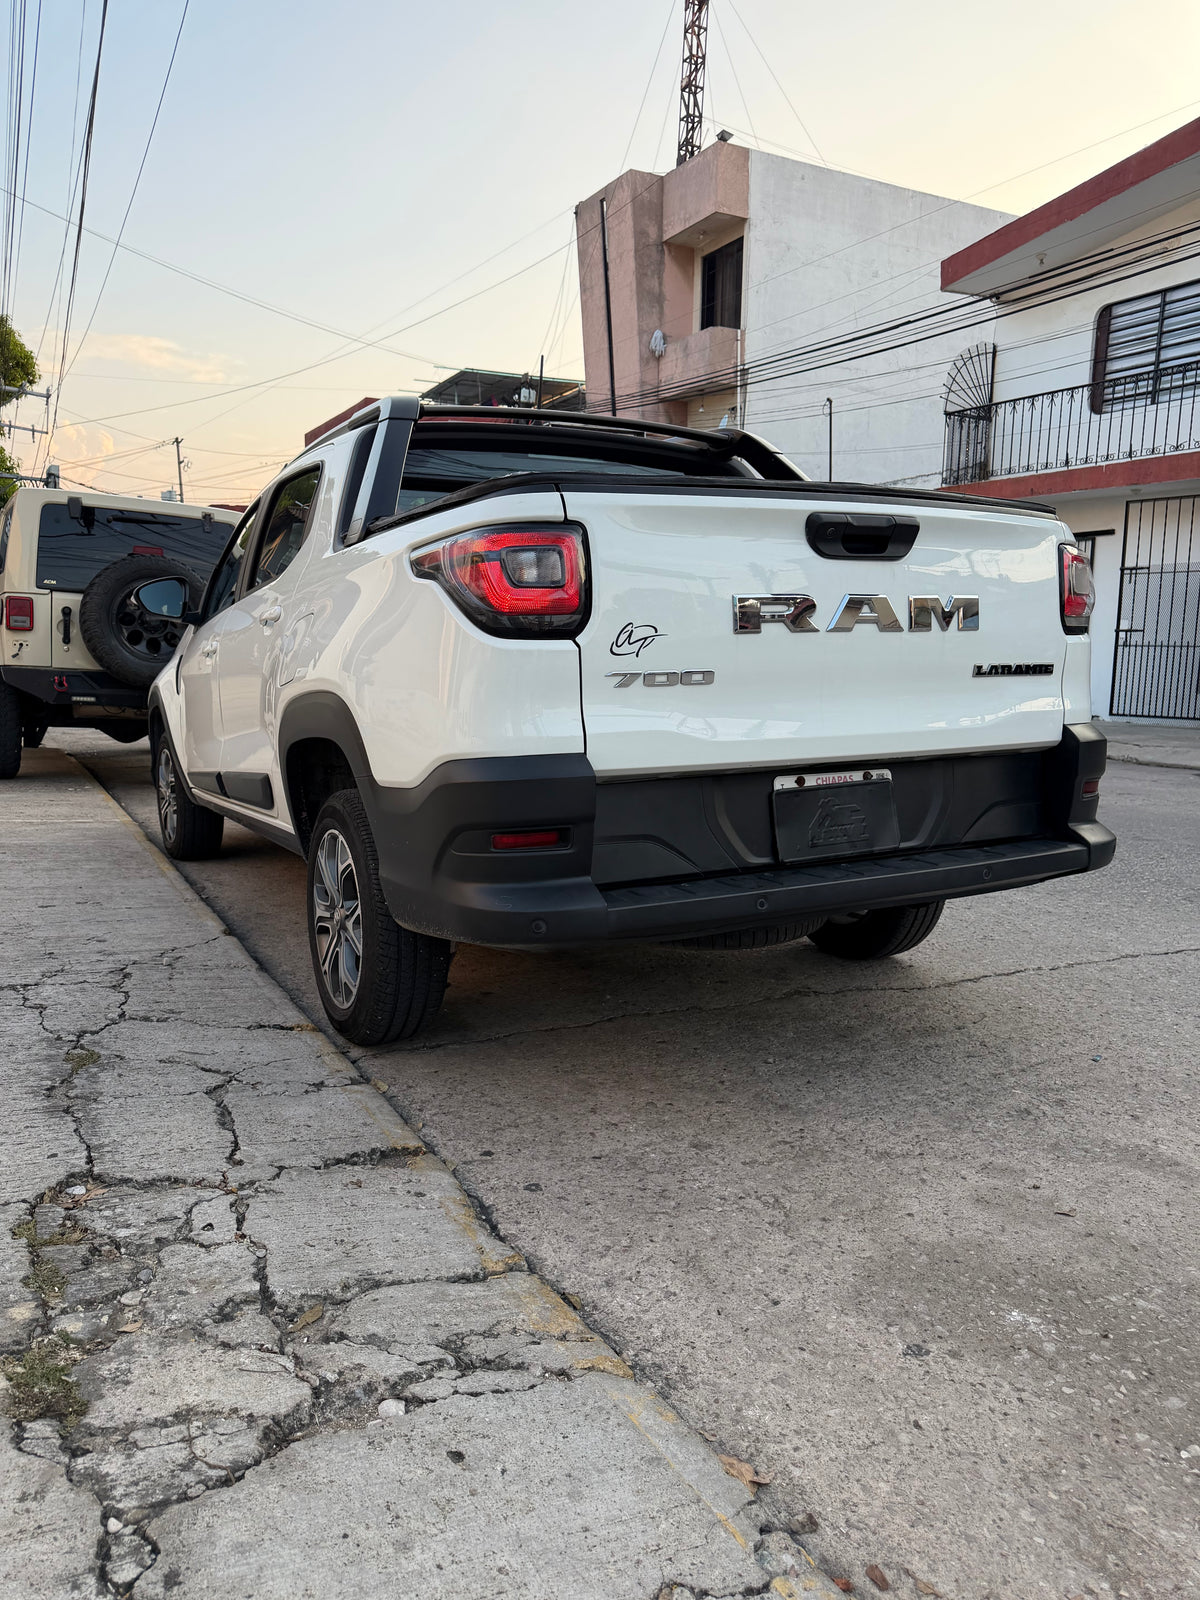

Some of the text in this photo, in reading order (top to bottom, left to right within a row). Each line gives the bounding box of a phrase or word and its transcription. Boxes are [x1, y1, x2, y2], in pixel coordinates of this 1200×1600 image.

[733, 593, 980, 634] RAM
[604, 668, 715, 688] 700
[972, 662, 1054, 678] LARAMIE
[815, 774, 854, 786] CHIAPAS
